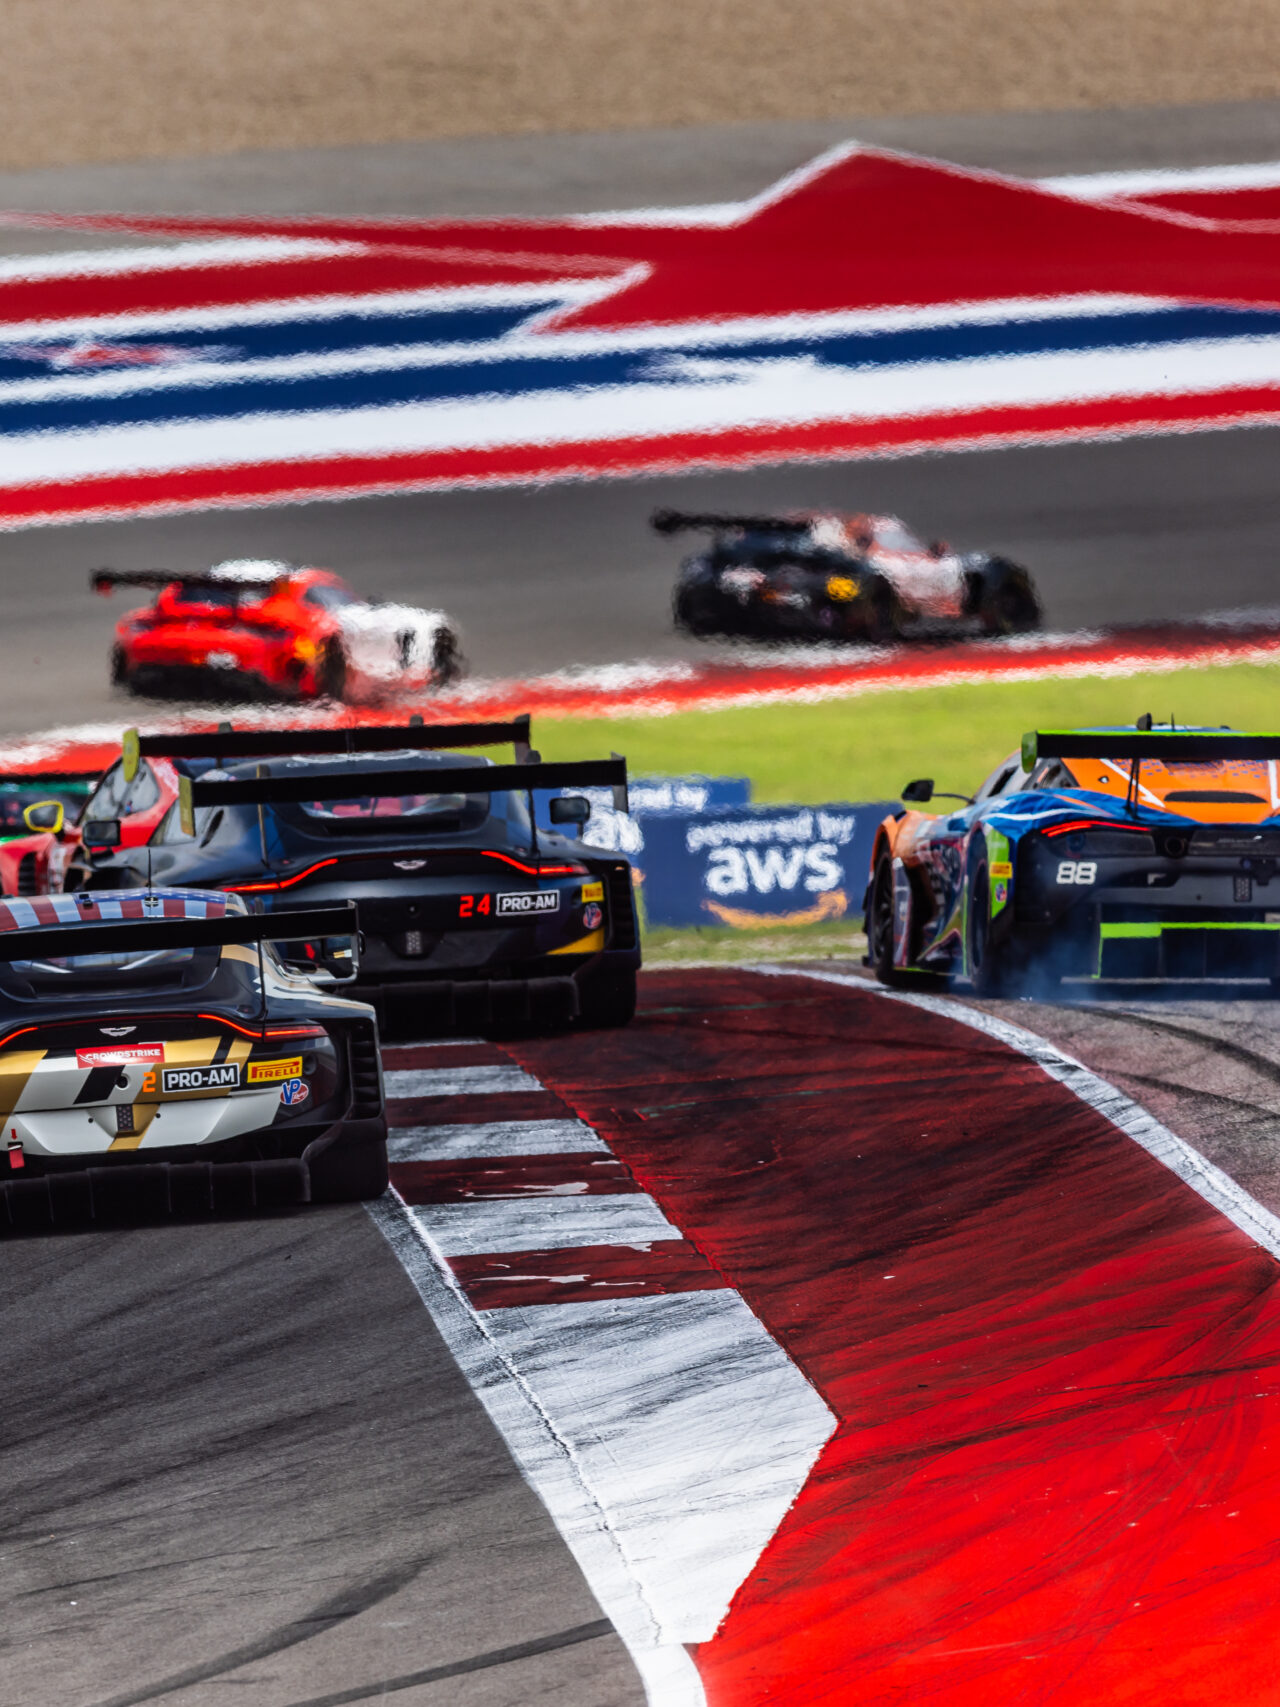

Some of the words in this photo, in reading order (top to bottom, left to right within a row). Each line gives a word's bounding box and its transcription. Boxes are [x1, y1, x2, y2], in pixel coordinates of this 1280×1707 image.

[686, 809, 814, 852] powered
[816, 811, 856, 845] by
[706, 842, 843, 895] aws
[1056, 861, 1097, 885] 88
[459, 894, 491, 917] 24
[501, 894, 555, 911] PRO-AM
[84, 1048, 162, 1062] CROWDSTRIKE
[142, 1071, 156, 1093] 2
[167, 1067, 235, 1089] PRO-AM
[251, 1060, 300, 1079] PIRELLI
[281, 1078, 302, 1105] VP
